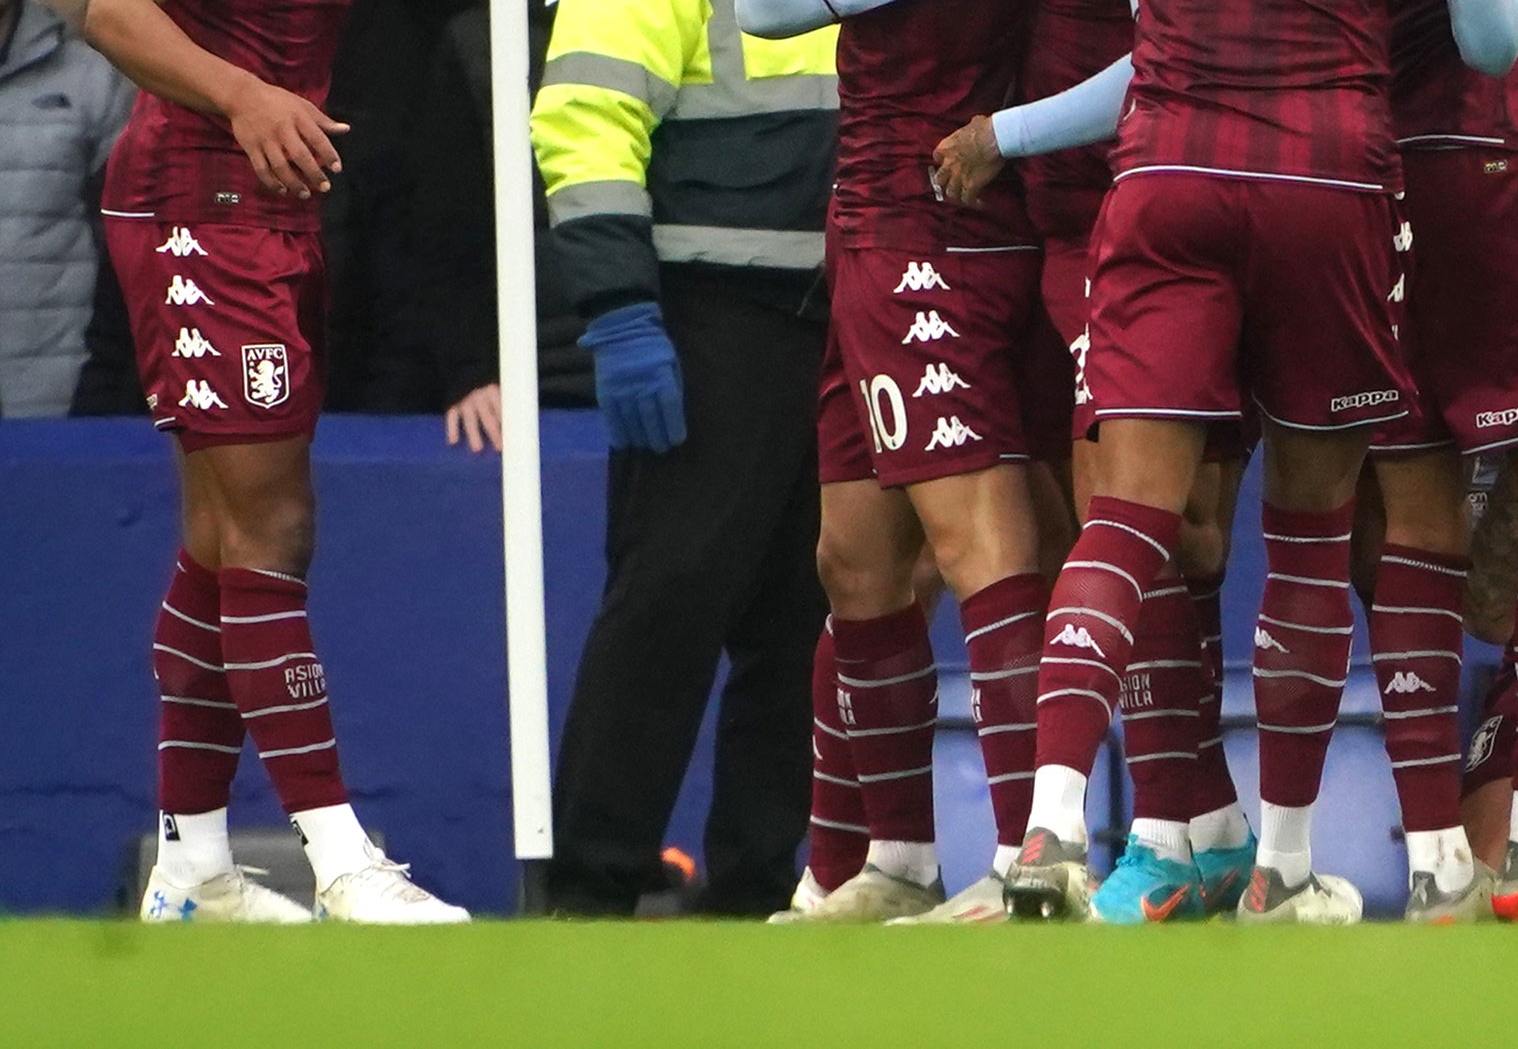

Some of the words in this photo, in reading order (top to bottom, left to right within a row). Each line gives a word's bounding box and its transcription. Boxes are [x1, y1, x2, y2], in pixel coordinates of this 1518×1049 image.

[247, 347, 284, 361] AVFC
[1331, 390, 1399, 412] Kappa
[859, 374, 908, 454] 10
